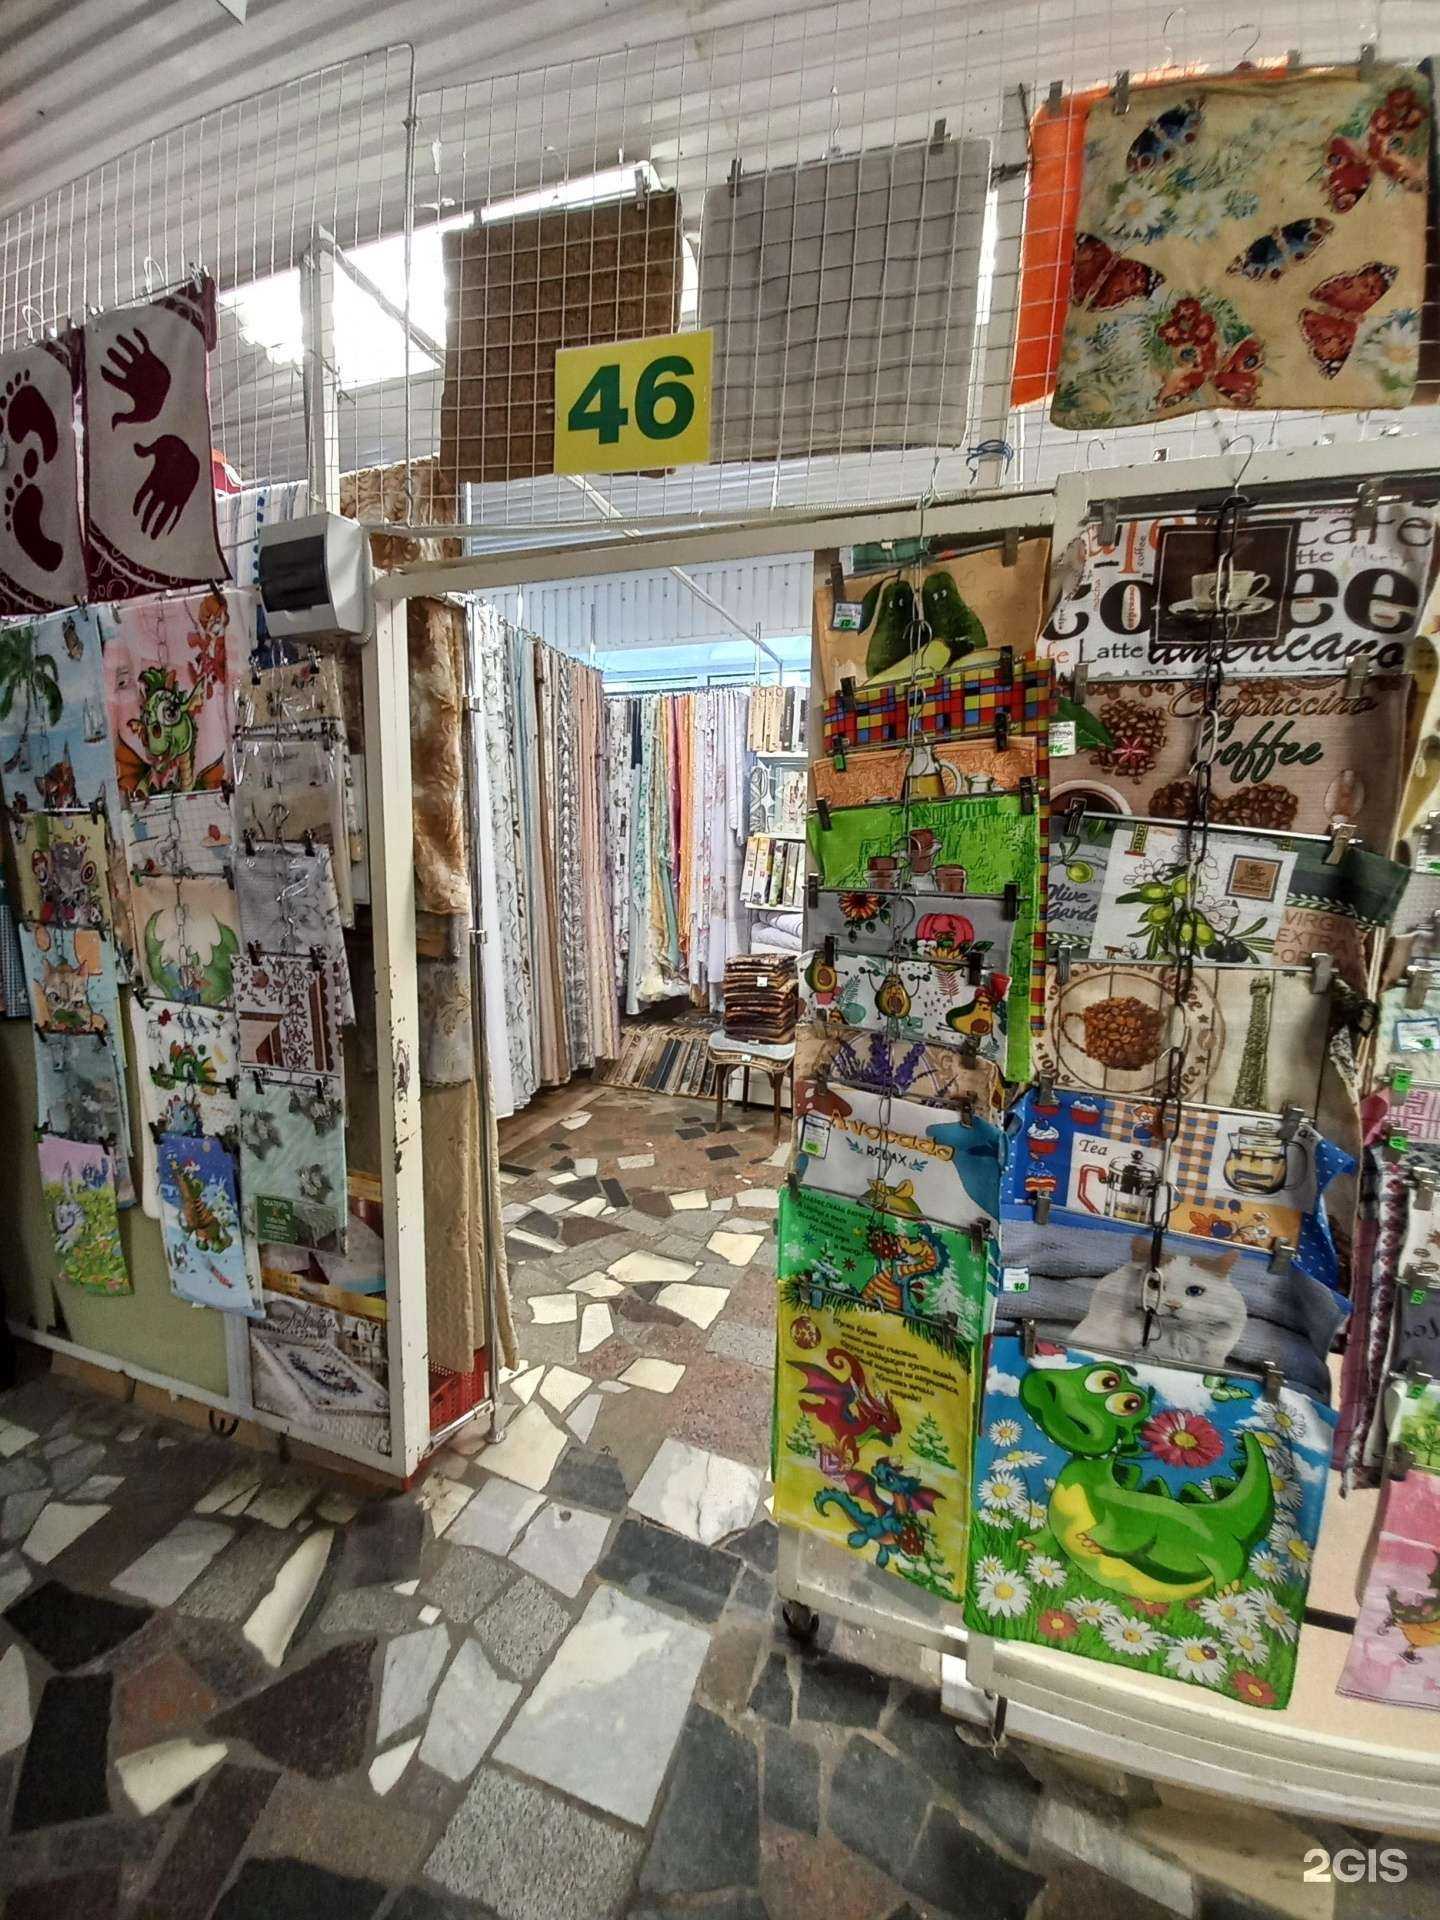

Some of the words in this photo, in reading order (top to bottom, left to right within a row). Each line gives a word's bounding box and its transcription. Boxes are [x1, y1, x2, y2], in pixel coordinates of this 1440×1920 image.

[568, 356, 695, 445] 46
[1079, 638, 1145, 664] Latte
[1079, 1139, 1108, 1156] Tea
